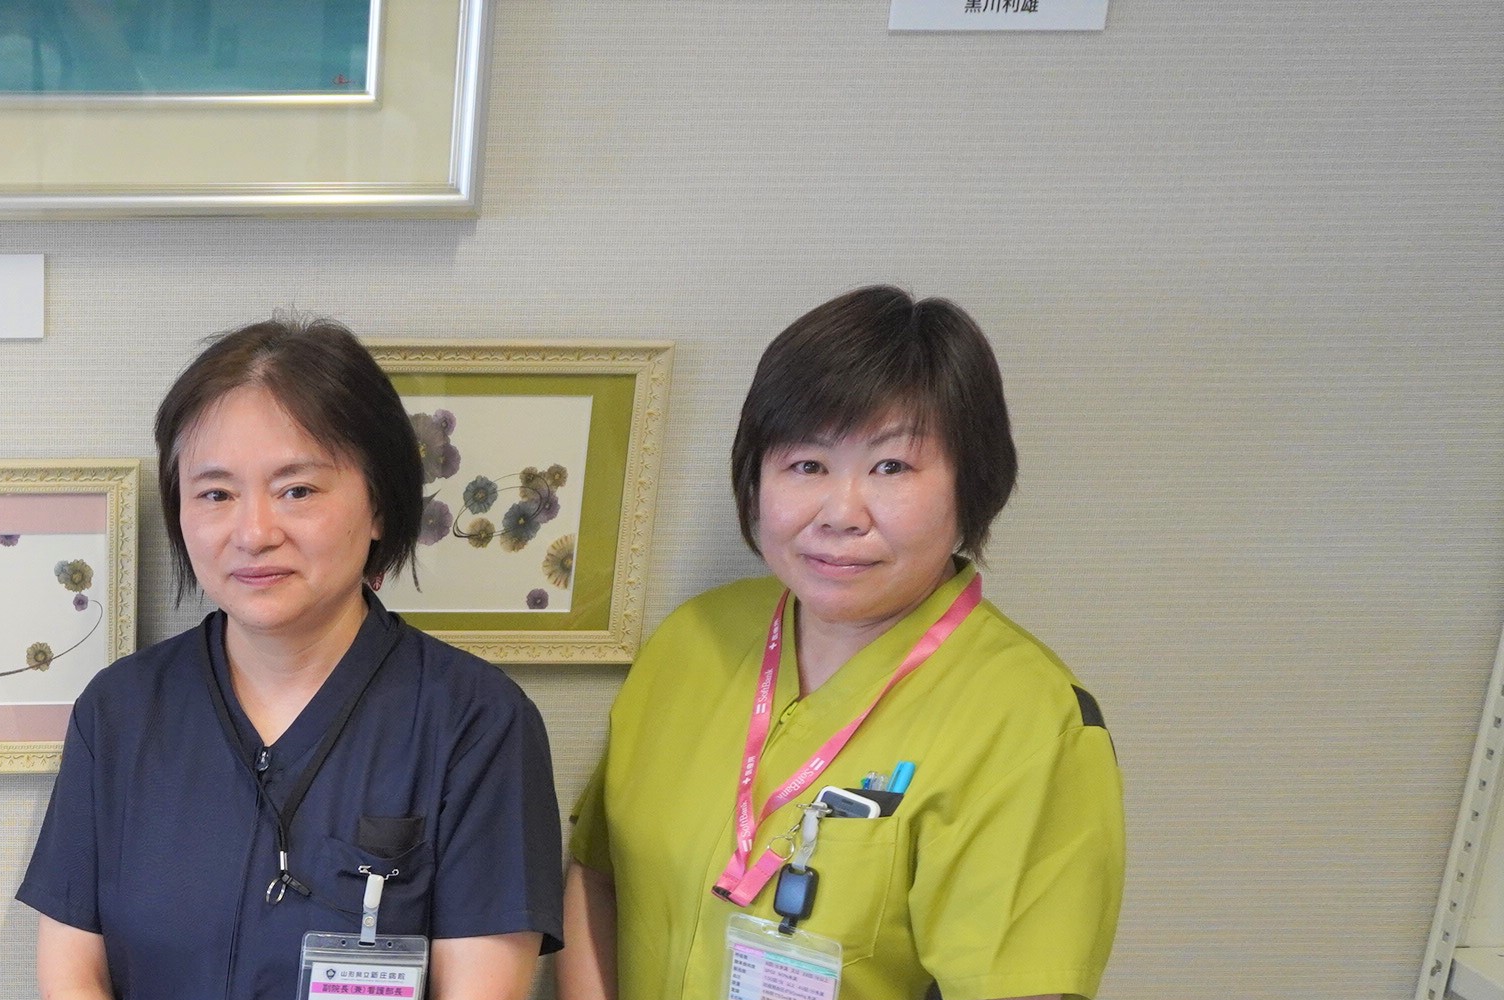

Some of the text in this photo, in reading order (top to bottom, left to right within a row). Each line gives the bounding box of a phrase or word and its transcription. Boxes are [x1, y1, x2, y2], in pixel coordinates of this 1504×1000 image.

[757, 667, 774, 703] SoftBank
[776, 767, 815, 801] SoftBank
[740, 799, 752, 839] SoftBank
